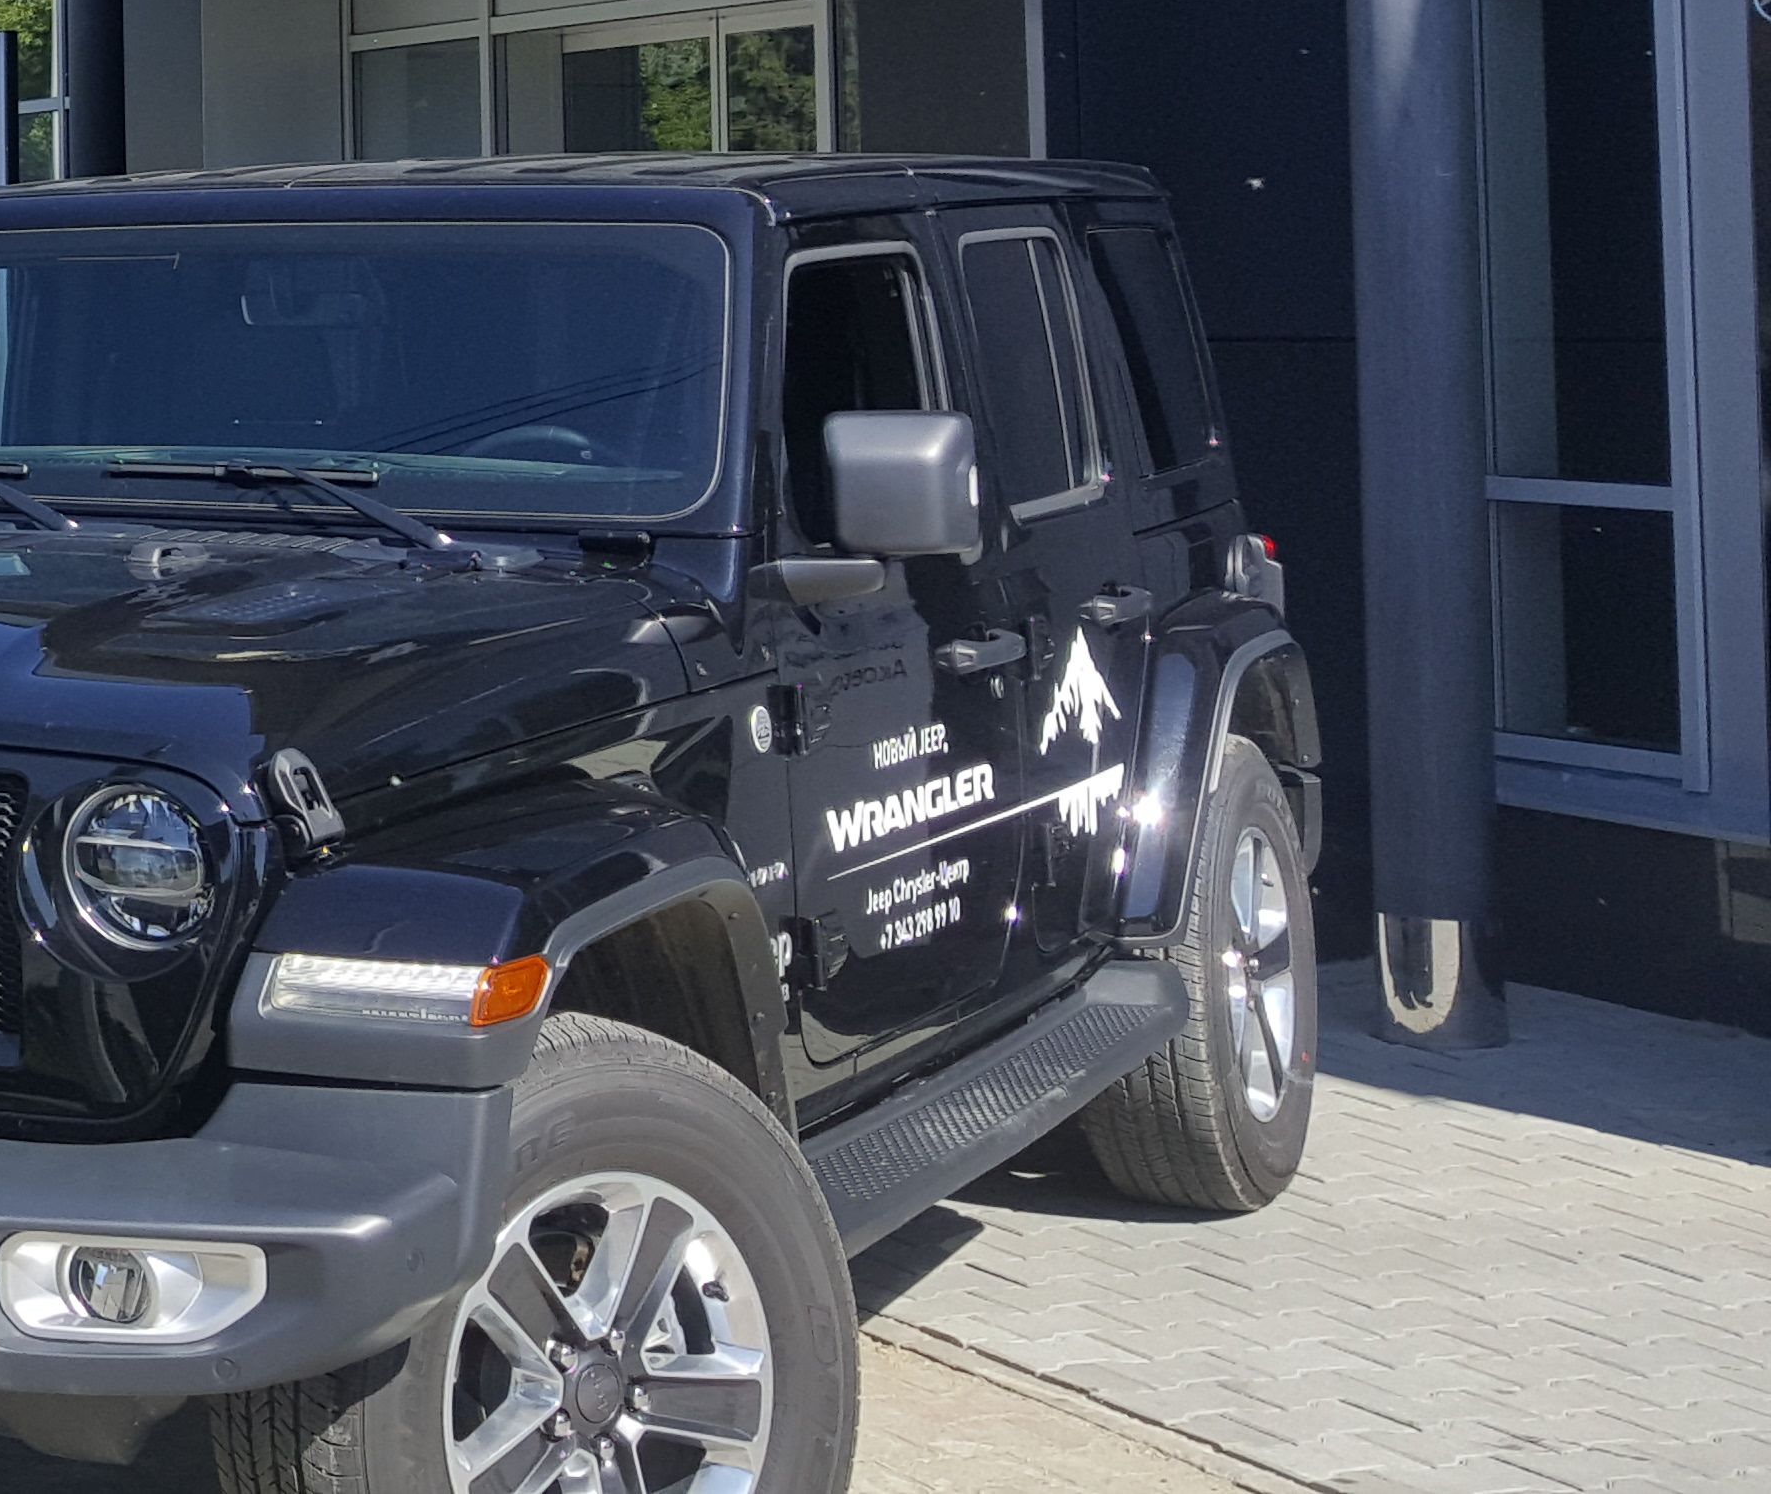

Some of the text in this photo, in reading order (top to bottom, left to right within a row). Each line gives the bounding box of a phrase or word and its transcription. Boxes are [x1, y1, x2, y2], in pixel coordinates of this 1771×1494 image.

[873, 727, 918, 769] НОВЫЙ
[826, 763, 995, 852] WRANGLER
[866, 888, 892, 915] Jeep
